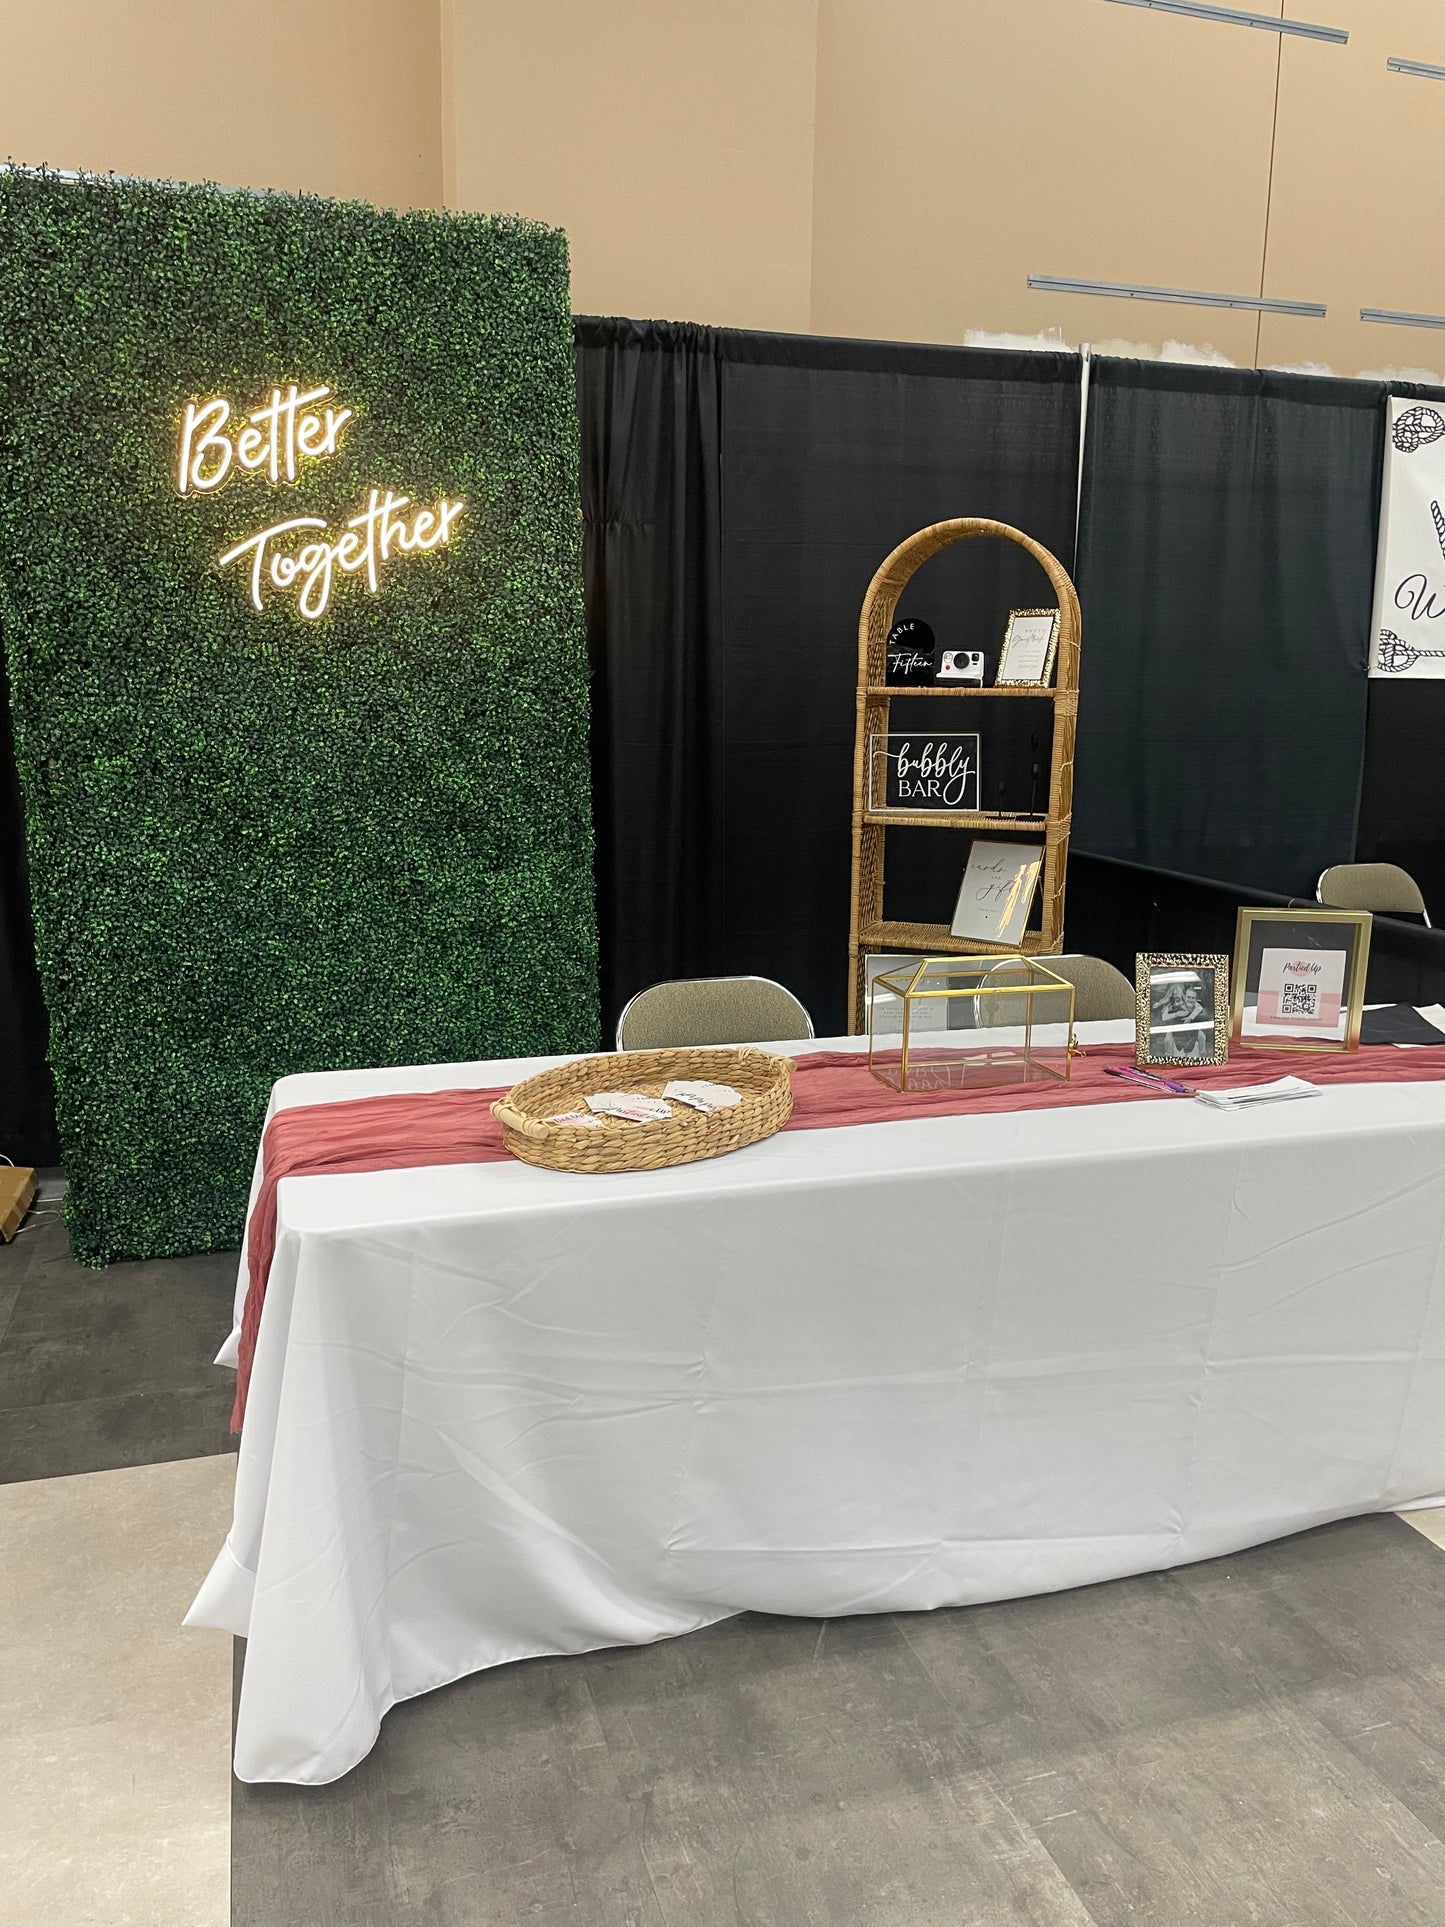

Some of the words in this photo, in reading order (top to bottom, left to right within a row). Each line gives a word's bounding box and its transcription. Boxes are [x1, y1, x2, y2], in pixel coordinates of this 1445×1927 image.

[178, 384, 353, 494] Better
[218, 488, 465, 619] Together
[888, 622, 915, 645] TABLE
[887, 652, 933, 675] Fifteen
[873, 742, 976, 805] bubbly
[898, 779, 942, 798] BAR
